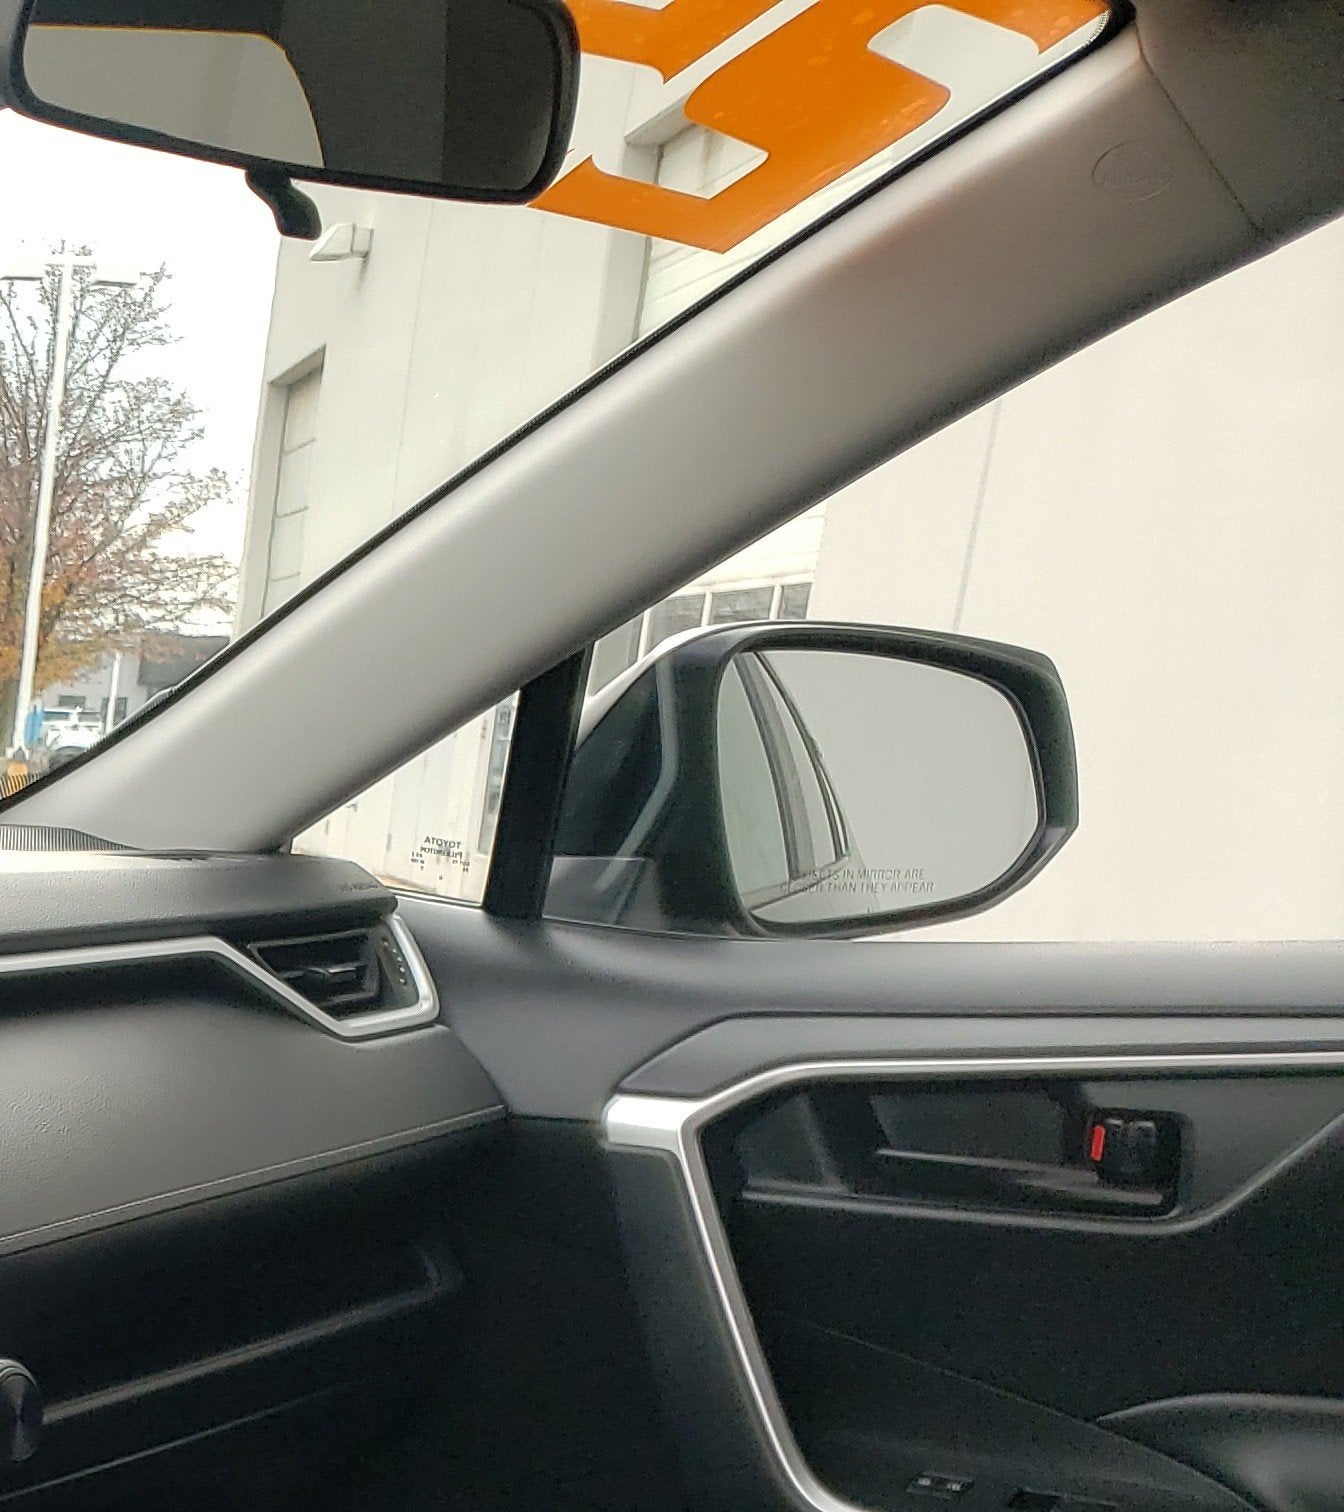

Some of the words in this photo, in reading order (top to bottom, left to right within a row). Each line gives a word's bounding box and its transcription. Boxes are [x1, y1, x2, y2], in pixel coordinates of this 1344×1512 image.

[857, 867, 901, 880] MIRROR
[904, 867, 925, 880] ARE
[827, 881, 857, 894] THAN
[891, 881, 934, 894] APPEAR
